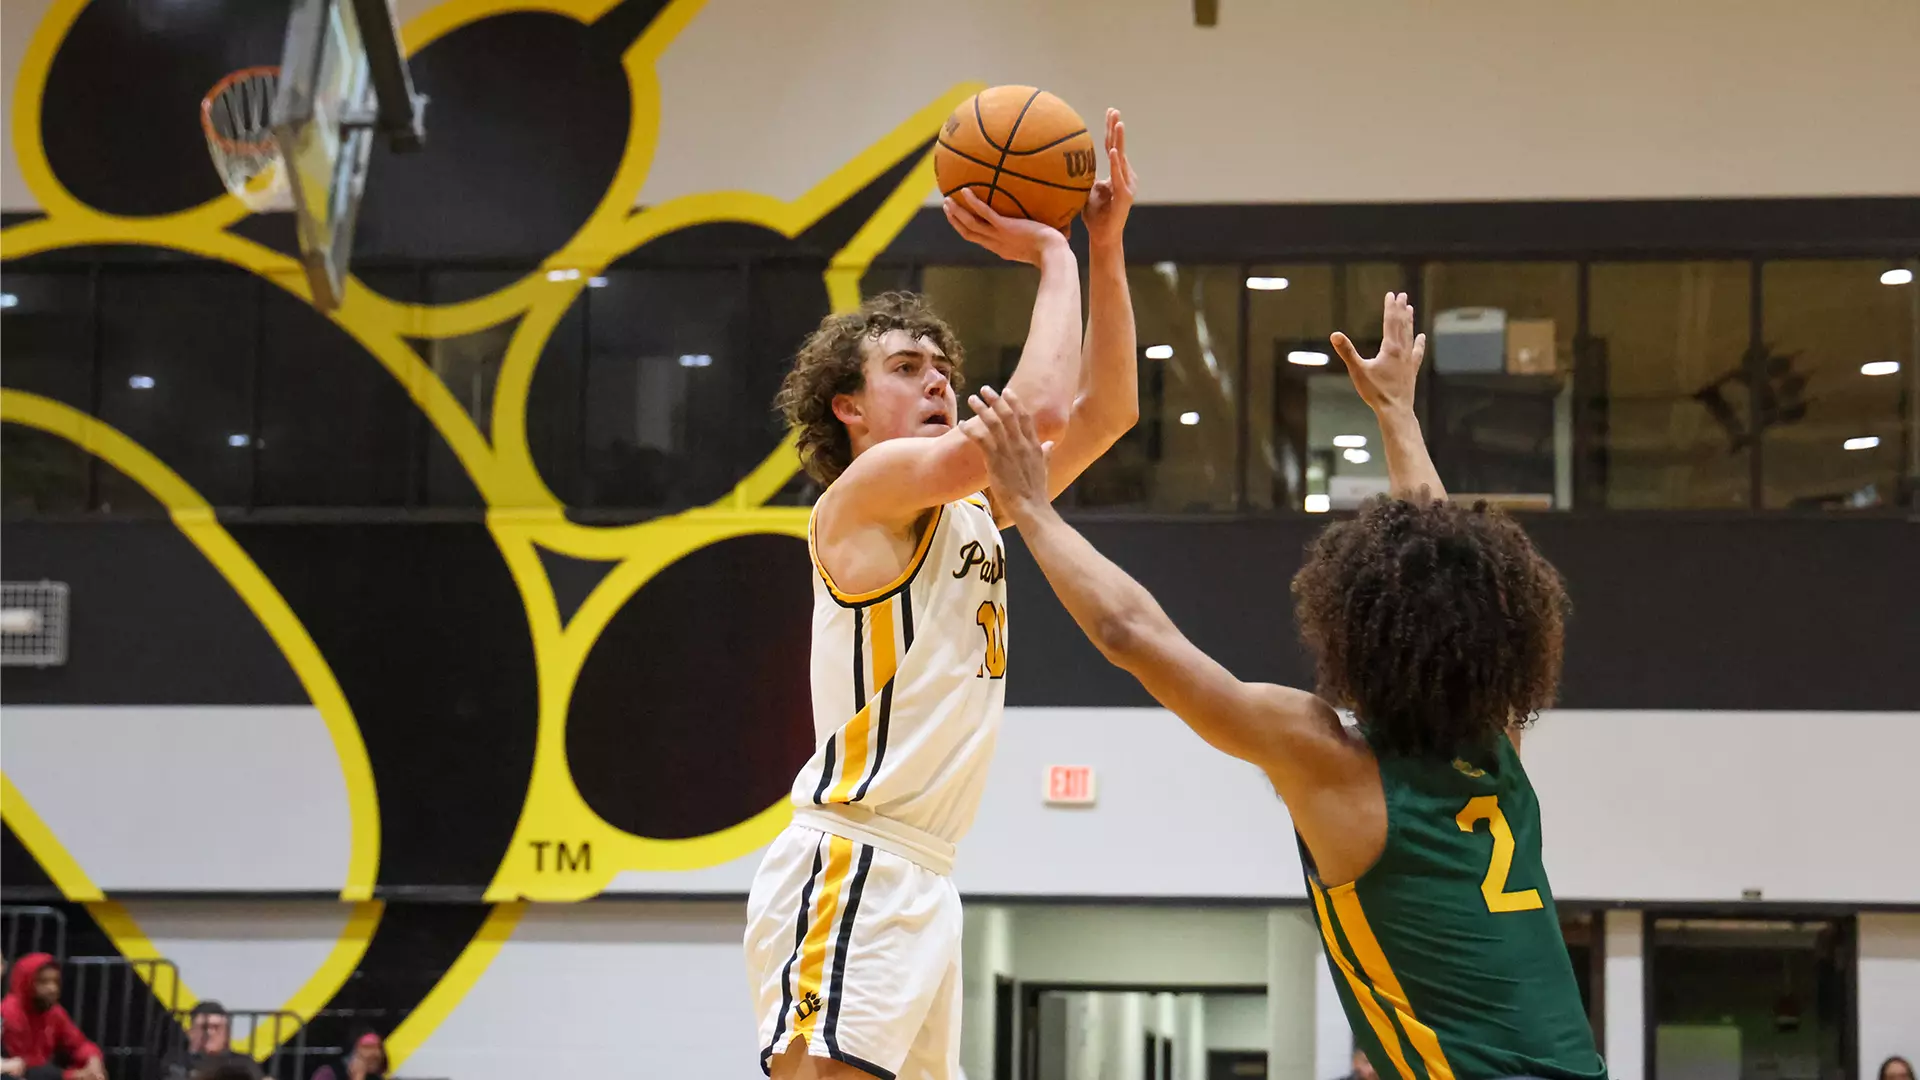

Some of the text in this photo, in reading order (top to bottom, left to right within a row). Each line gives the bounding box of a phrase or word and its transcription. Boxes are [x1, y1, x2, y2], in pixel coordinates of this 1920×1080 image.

[1050, 766, 1089, 799] EXIT
[529, 841, 591, 872] TM
[1456, 795, 1544, 913] 2
